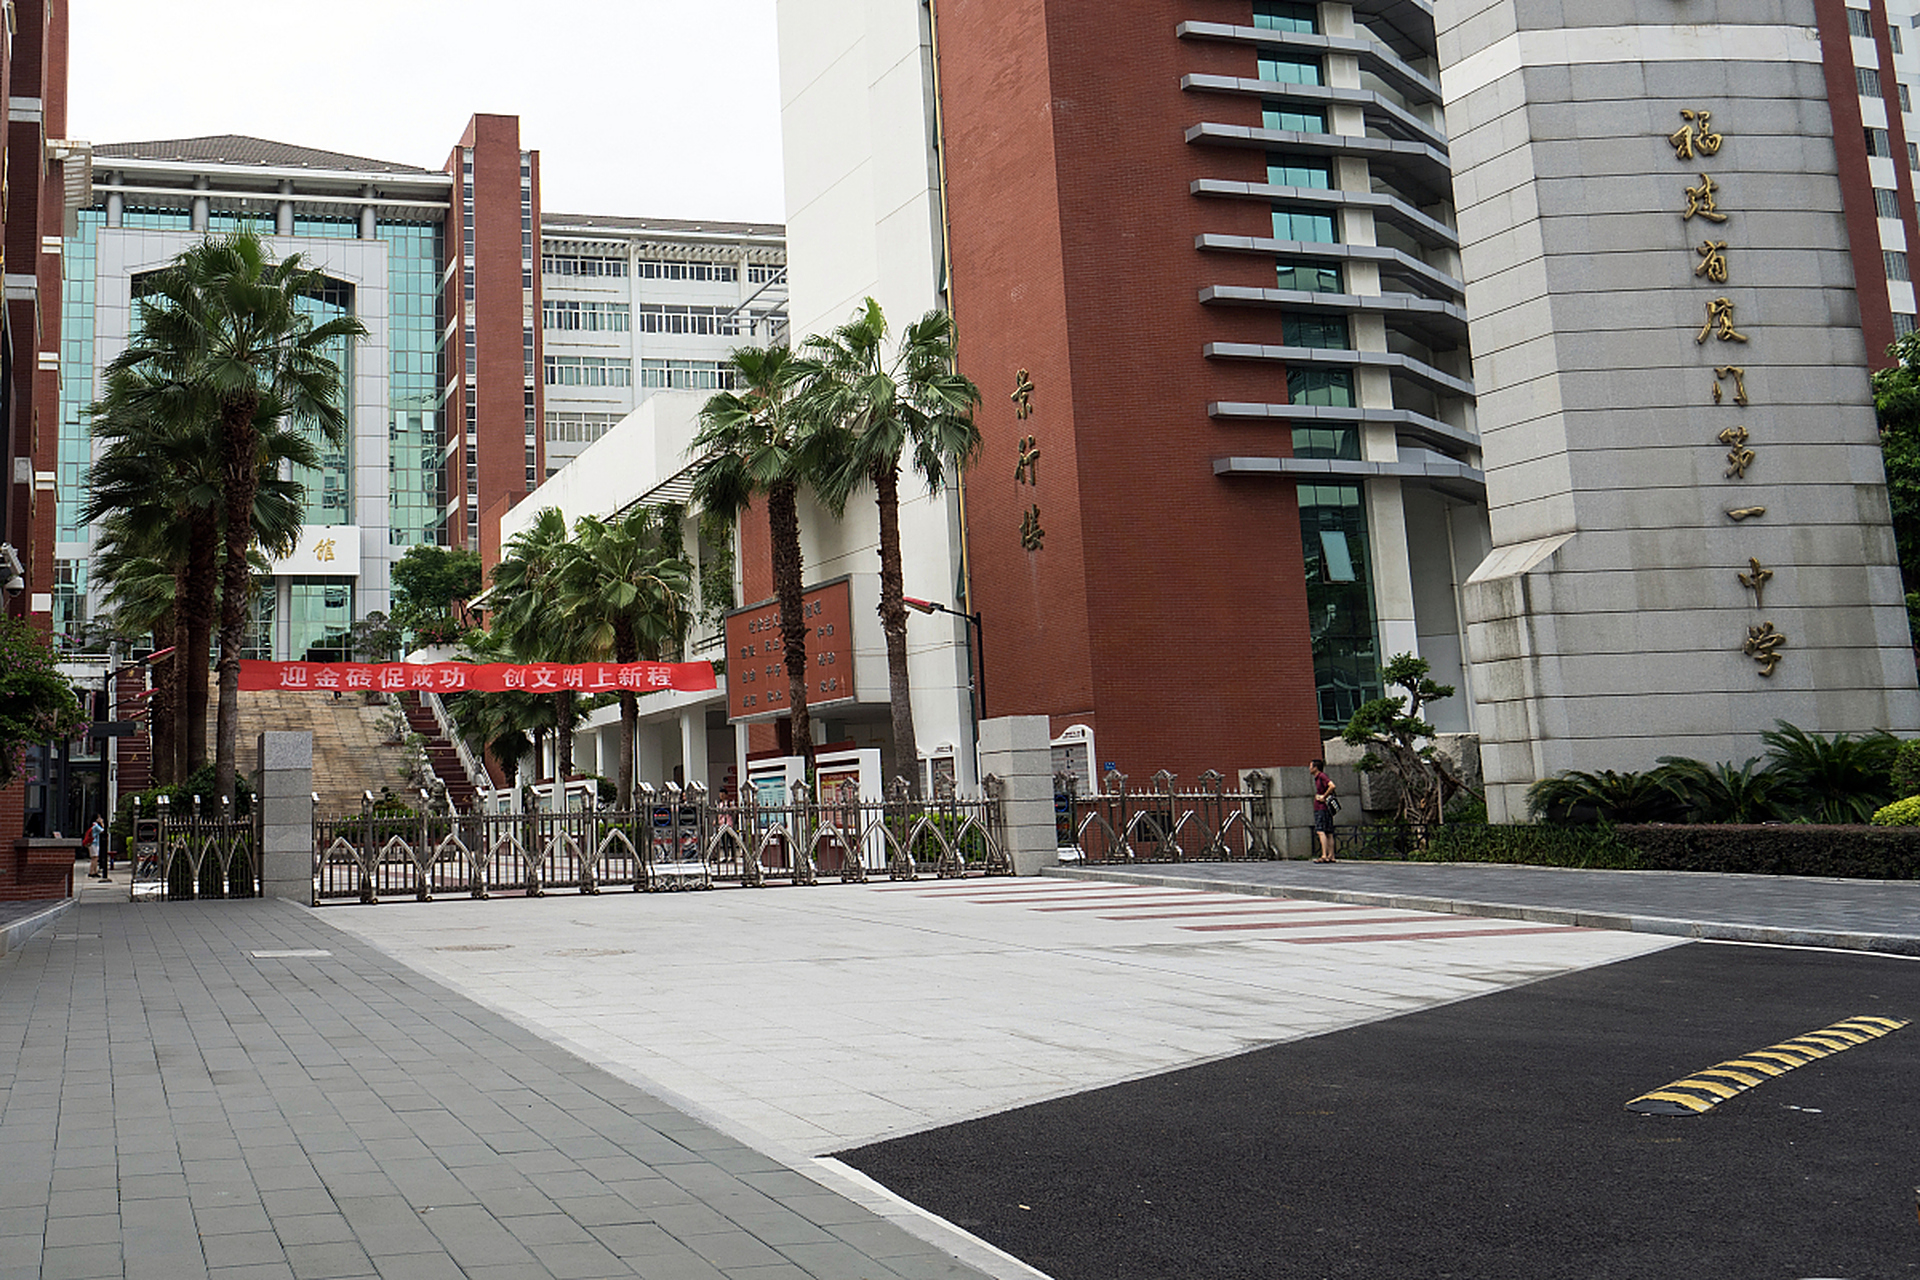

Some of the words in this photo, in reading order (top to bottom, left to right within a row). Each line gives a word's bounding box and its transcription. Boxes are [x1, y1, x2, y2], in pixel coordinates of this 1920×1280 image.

[1668, 109, 1788, 678] 福建省厦门第一中学
[280, 665, 466, 689] 迎金砖促成功
[502, 666, 673, 688] 创文明上新程
